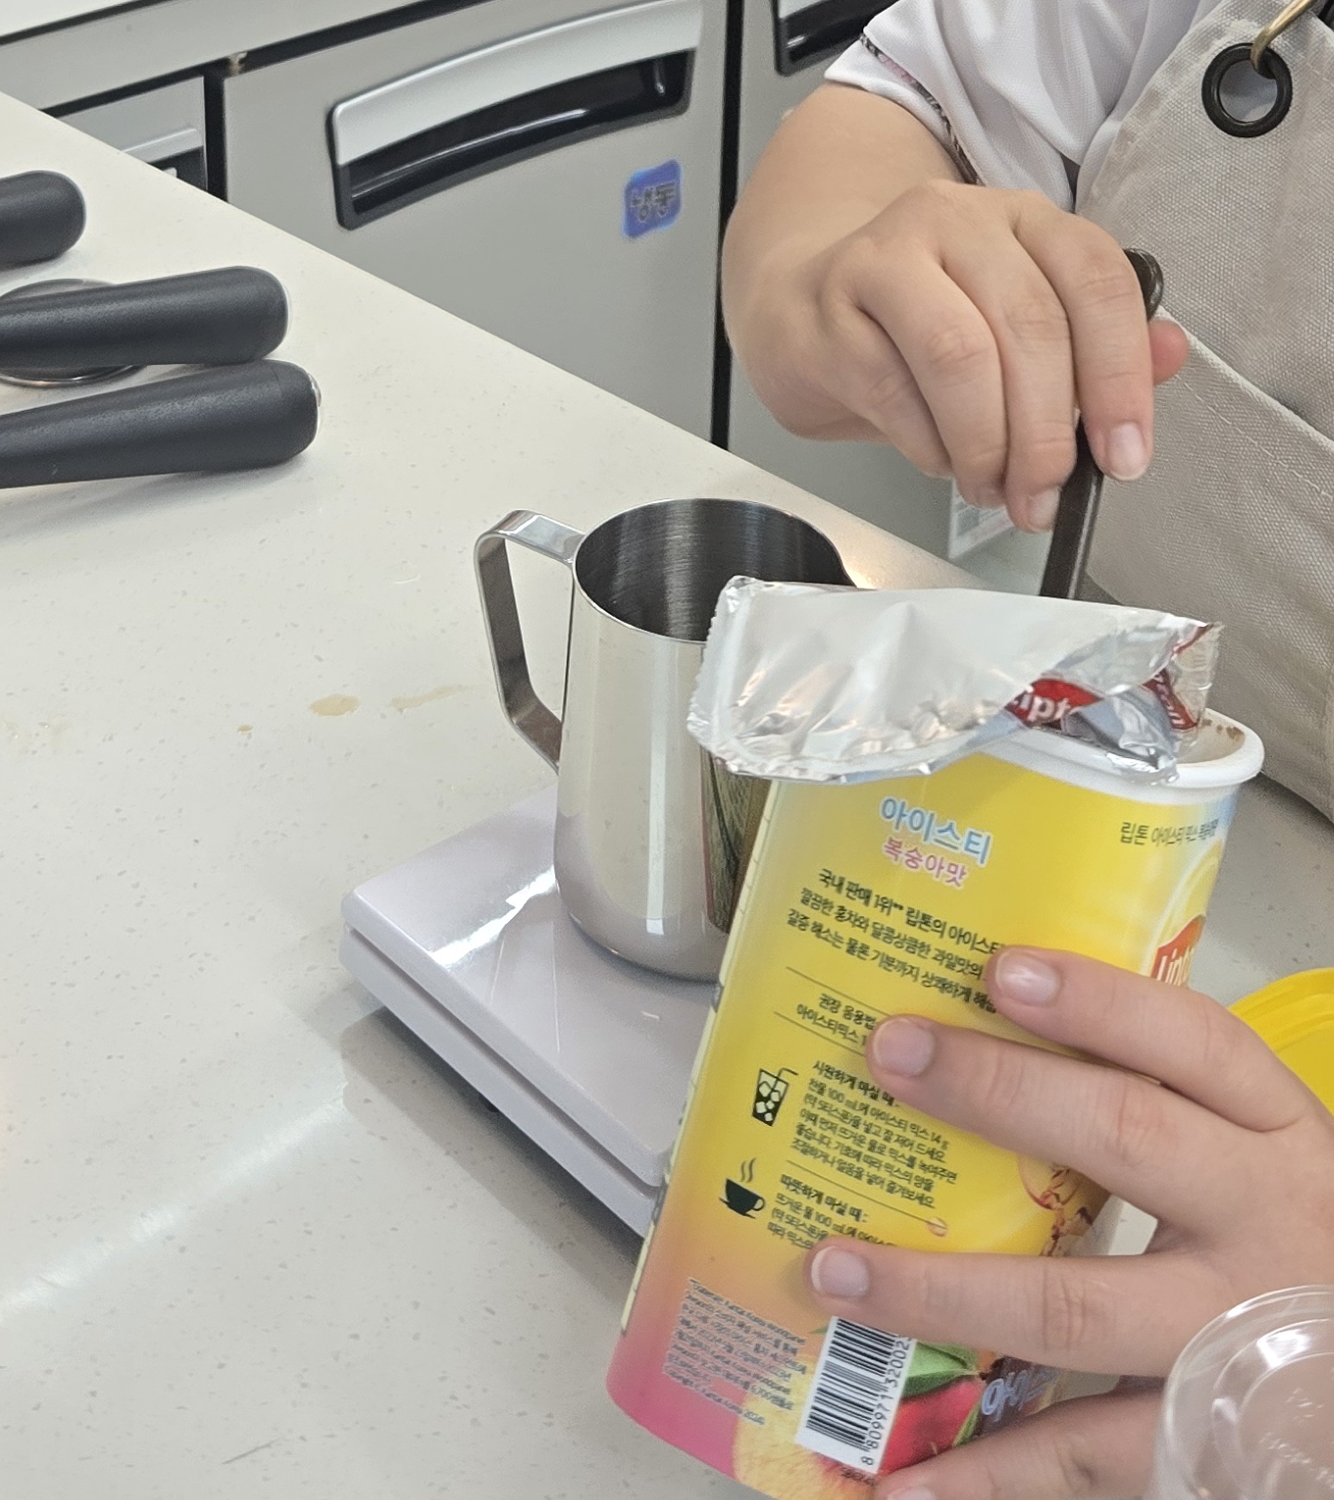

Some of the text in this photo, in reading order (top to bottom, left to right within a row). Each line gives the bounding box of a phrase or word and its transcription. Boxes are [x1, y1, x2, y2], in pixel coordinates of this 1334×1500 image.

[880, 797, 992, 865] 아이스티
[1120, 821, 1150, 846] 립톤
[883, 836, 967, 887] 복숭아맛
[818, 868, 846, 894] 국내
[845, 880, 873, 906] 판매
[905, 906, 947, 939] 립톤의
[787, 908, 811, 932] 갈증
[810, 919, 845, 949] 해소는
[845, 937, 870, 961] 물론
[871, 949, 921, 983] 기분까지
[921, 970, 972, 1003] 상쾌하게
[799, 887, 984, 981] 깔끔한 홍차와 달콤상큼한 과일맛의
[796, 1002, 859, 1046] 아이스티믹스
[818, 993, 842, 1015] 권장
[812, 1059, 858, 1091] 시원하게
[858, 1079, 881, 1101] 마실
[827, 1086, 845, 1104] 100
[869, 1106, 909, 1132] 아이스티
[779, 1173, 824, 1205] 따뜻하게
[824, 1194, 849, 1217] 마실
[814, 1211, 833, 1228] 100
[860, 1337, 912, 1466] 8 809971 32002
